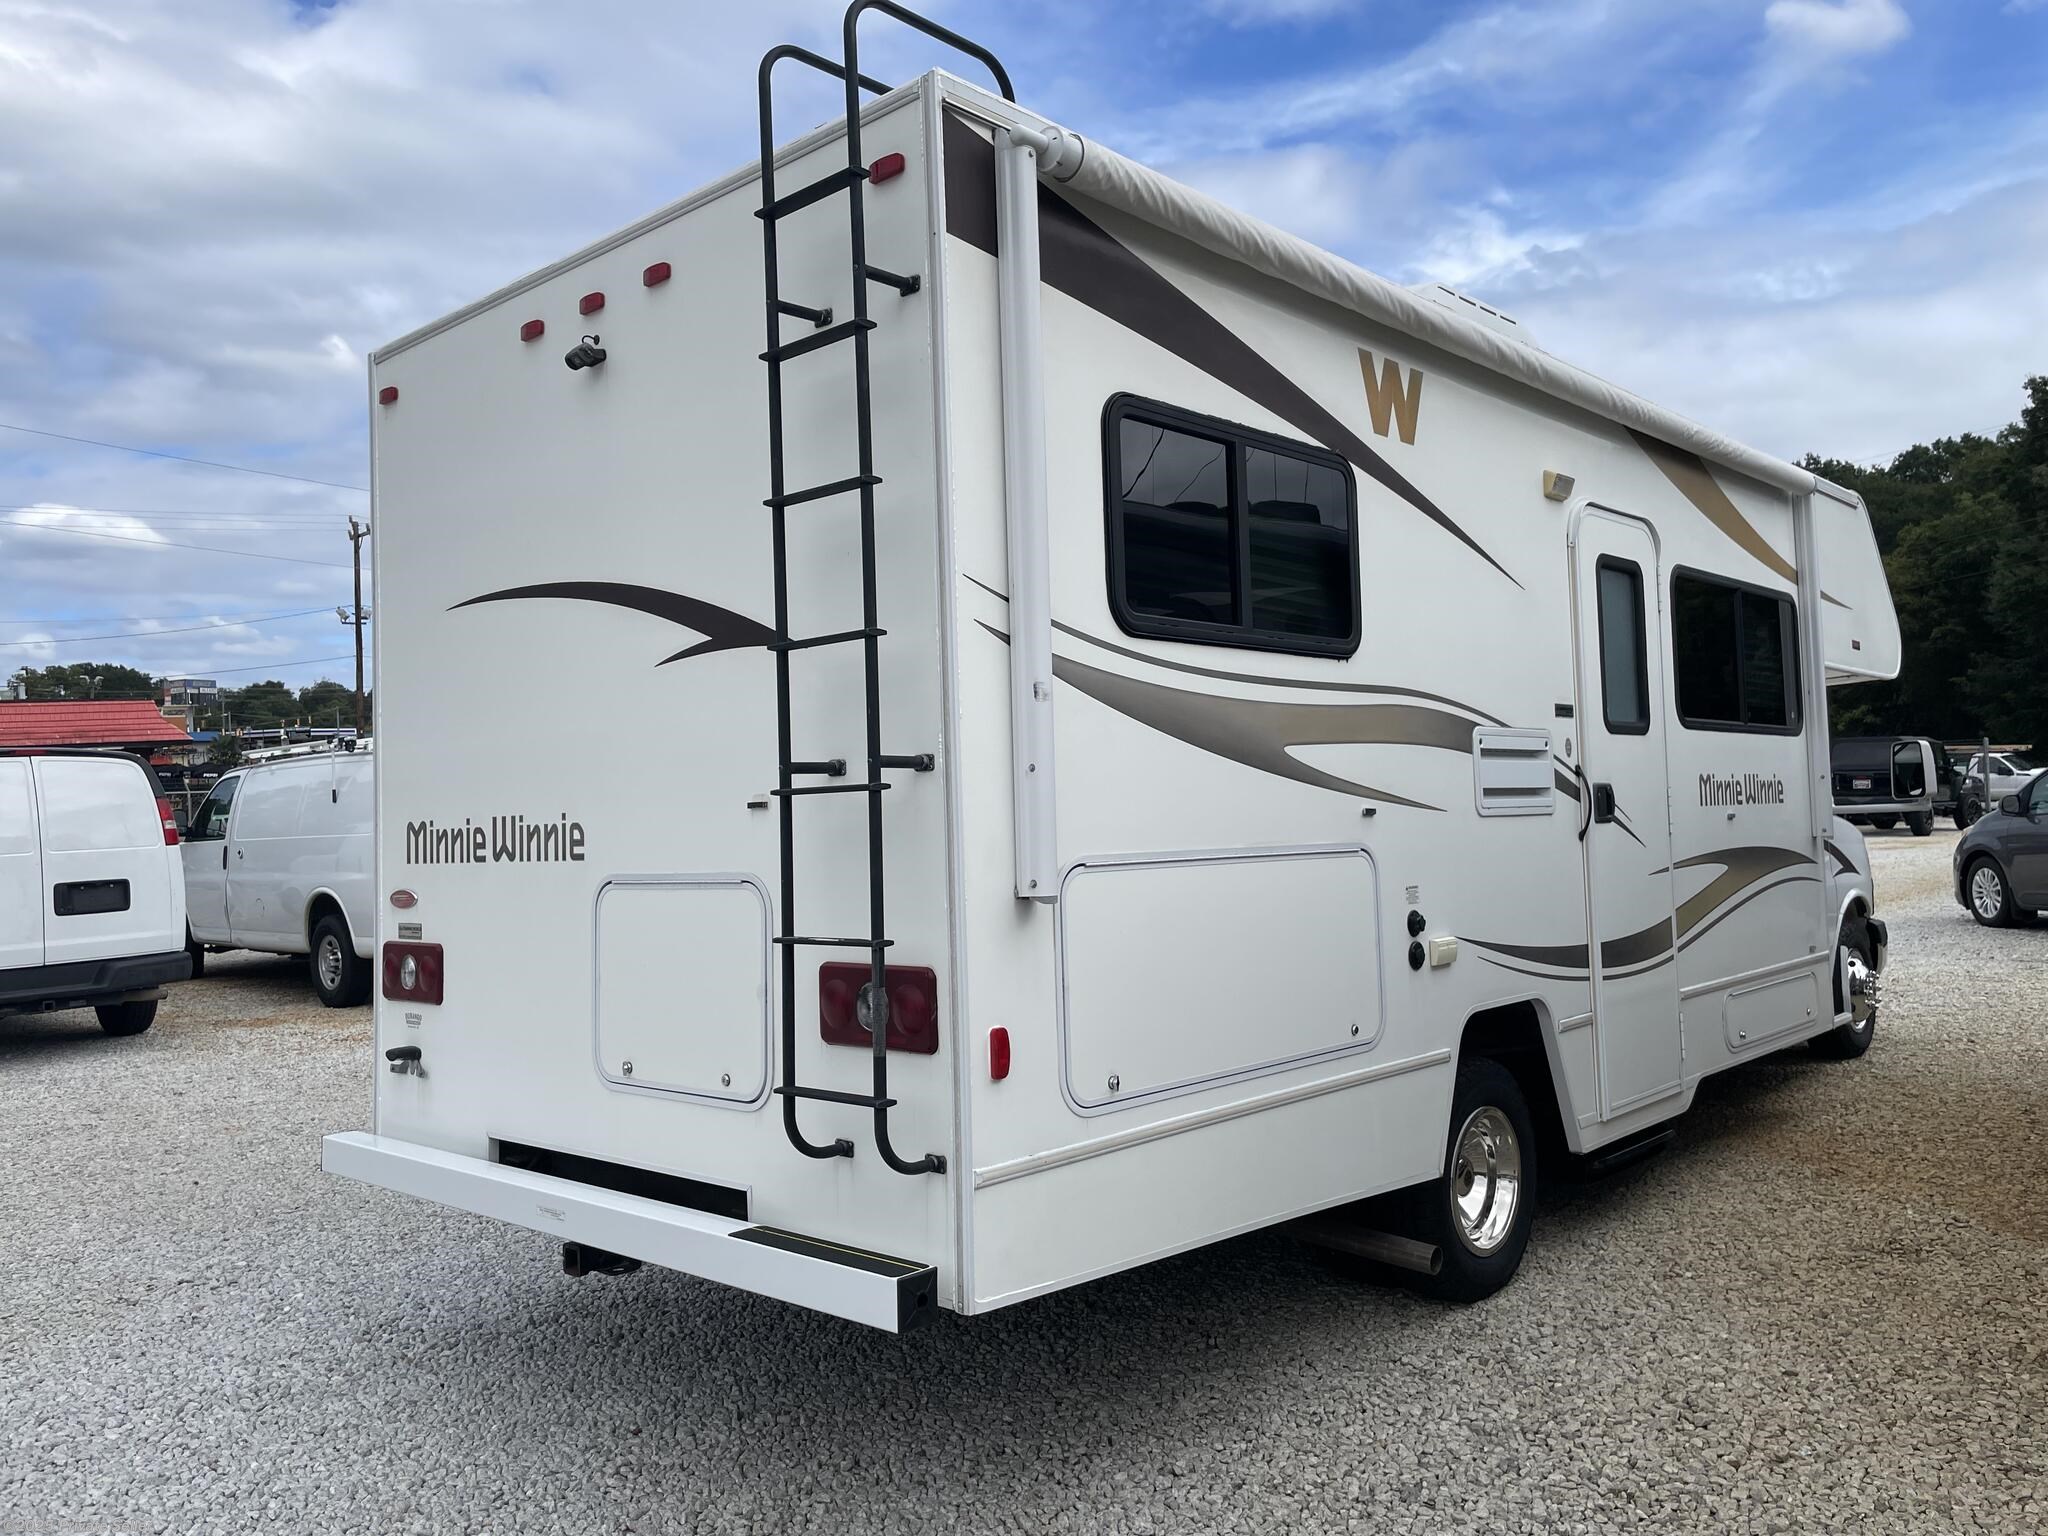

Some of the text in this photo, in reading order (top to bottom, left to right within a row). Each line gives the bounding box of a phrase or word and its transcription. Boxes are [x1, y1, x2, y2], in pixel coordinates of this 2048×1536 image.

[1358, 347, 1424, 446] W
[1699, 773, 1784, 806] Minnie Winnie
[406, 812, 585, 864] Minnie Winnie
